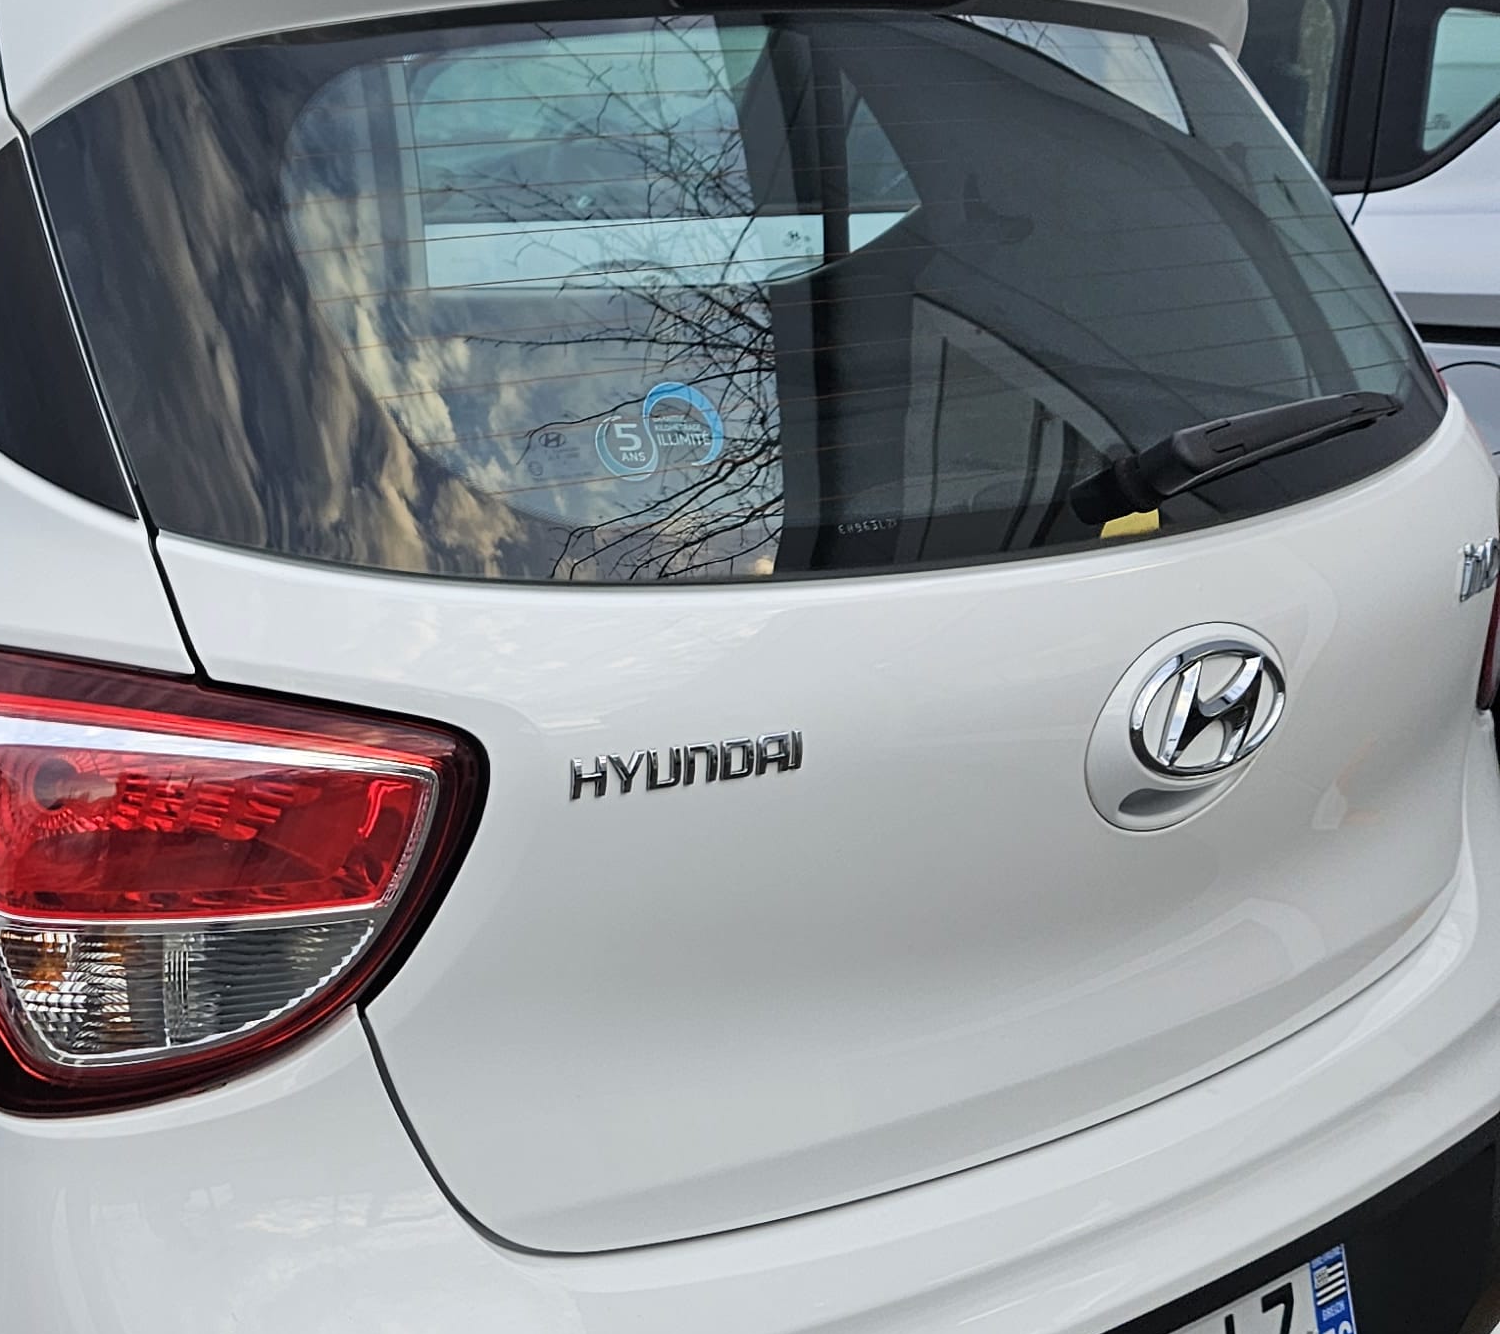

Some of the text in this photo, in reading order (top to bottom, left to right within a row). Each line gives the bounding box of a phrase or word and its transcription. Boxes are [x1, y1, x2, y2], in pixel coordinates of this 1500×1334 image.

[613, 423, 642, 452] 5
[656, 430, 712, 447] ILLIMITÉ
[621, 452, 647, 463] ANS
[569, 729, 803, 801] HYUNDAI
